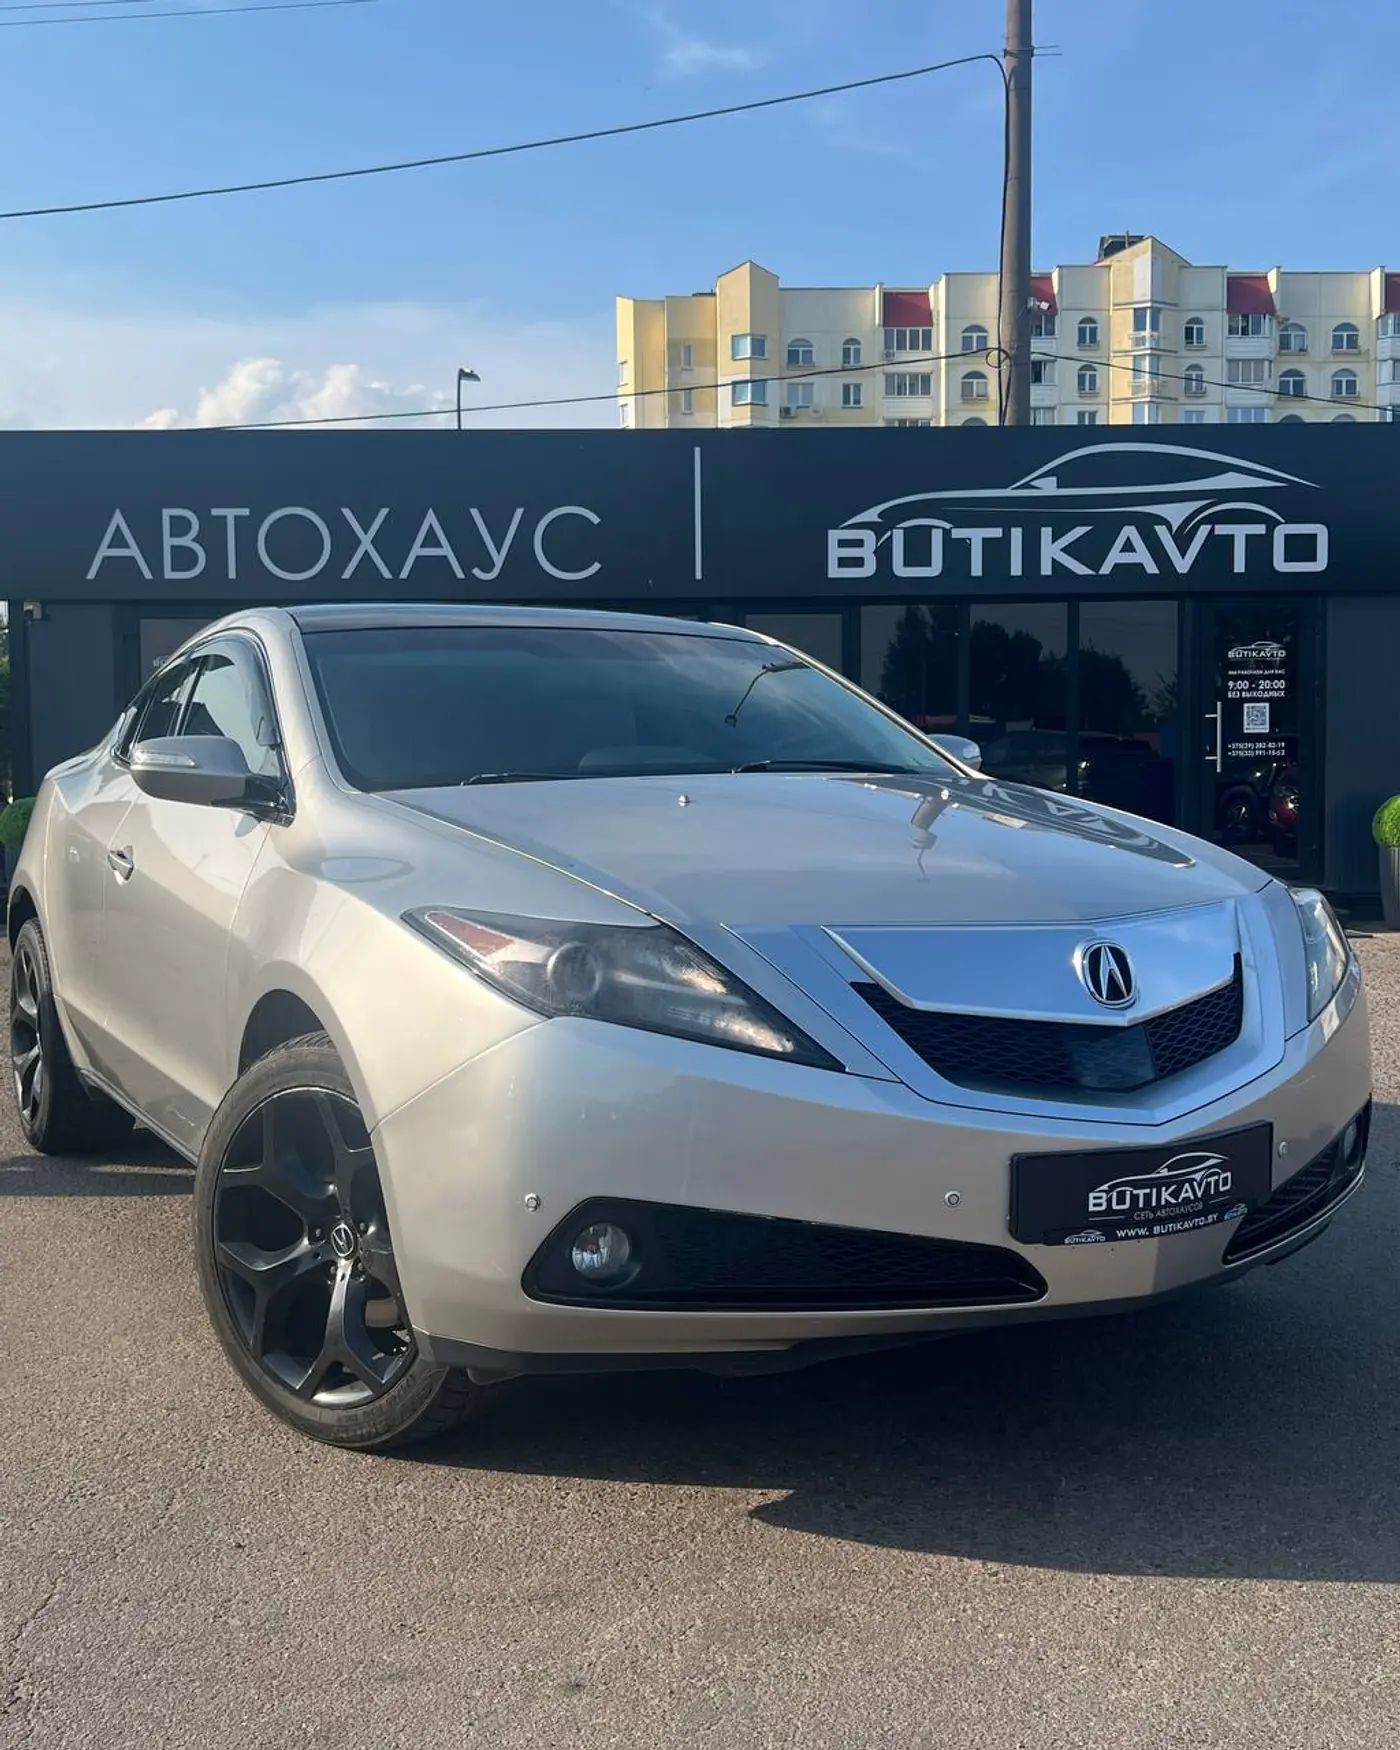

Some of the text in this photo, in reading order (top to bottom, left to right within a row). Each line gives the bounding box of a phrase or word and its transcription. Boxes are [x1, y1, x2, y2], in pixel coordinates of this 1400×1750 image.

[86, 505, 602, 581] АВТОХАУС
[827, 522, 1329, 579] BUTIKAVTO
[1228, 649, 1286, 658] BUTIKAVTO
[1228, 680, 1249, 690] 9:00
[1258, 679, 1286, 689] 20:00
[1241, 690, 1285, 698] ВЫХОДНЫХ
[1088, 1171, 1232, 1212] BUTIKAVTO
[1133, 1209, 1154, 1221] СЕТЬ
[1153, 1212, 1220, 1235] BUTIKAVTO.BY
[1064, 1234, 1107, 1245] BUTIKAVTO
